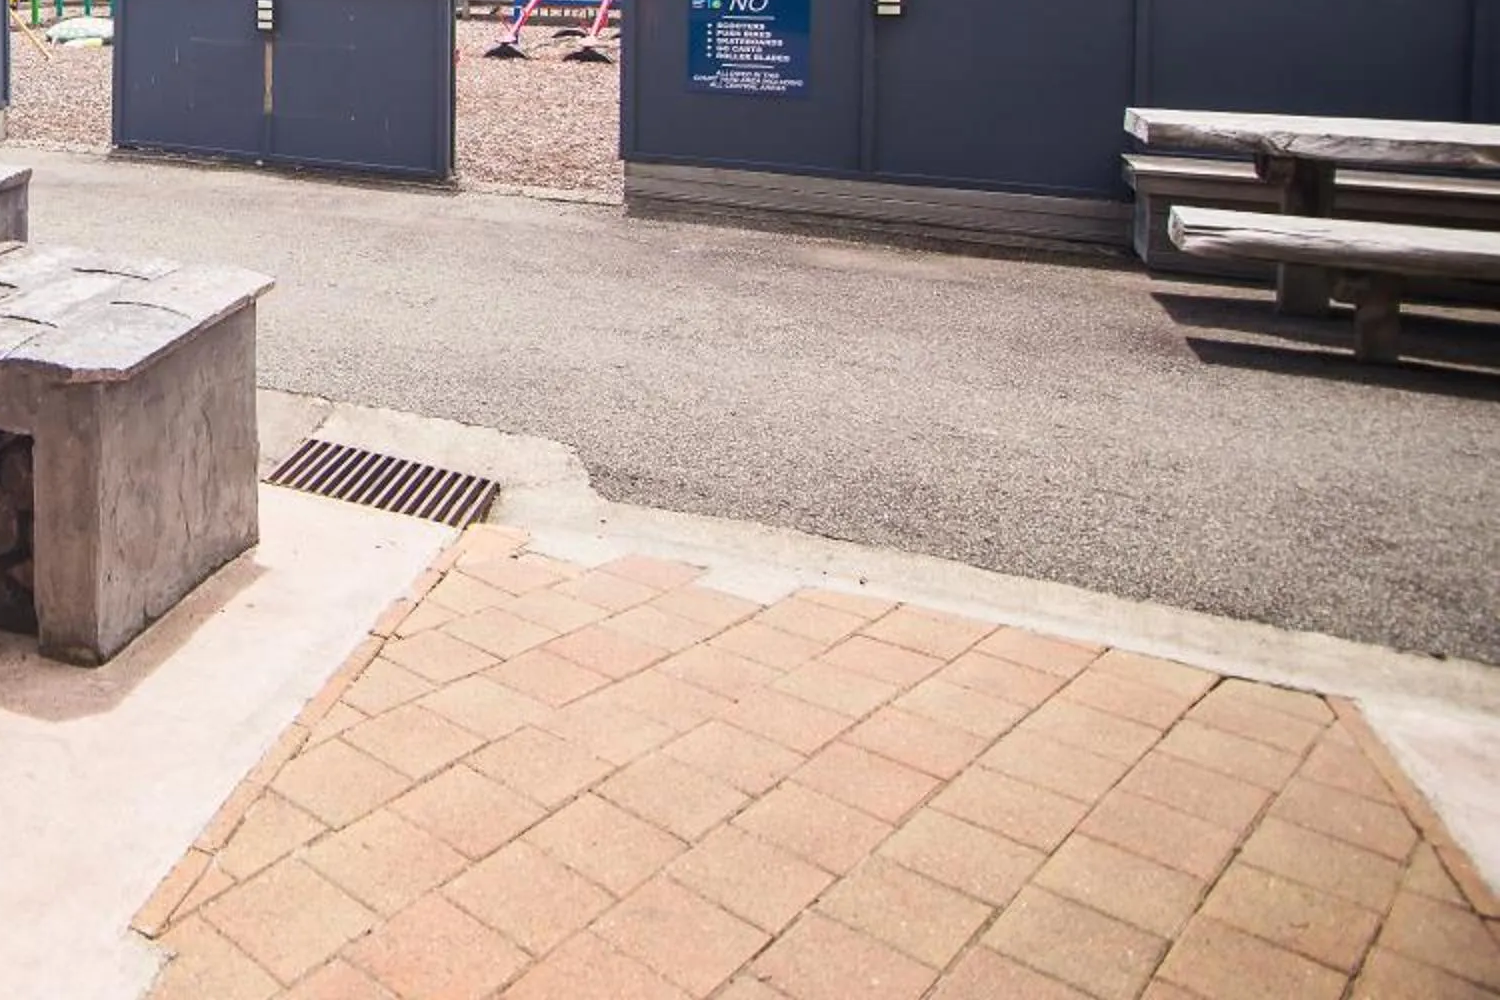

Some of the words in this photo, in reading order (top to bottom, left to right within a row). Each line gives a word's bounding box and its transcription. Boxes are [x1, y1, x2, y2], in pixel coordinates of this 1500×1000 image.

[716, 30, 742, 38] PUSH
[716, 38, 783, 46] SKATEBOARDS
[716, 53, 751, 61] ROLLER
[753, 54, 791, 62] BLADES
